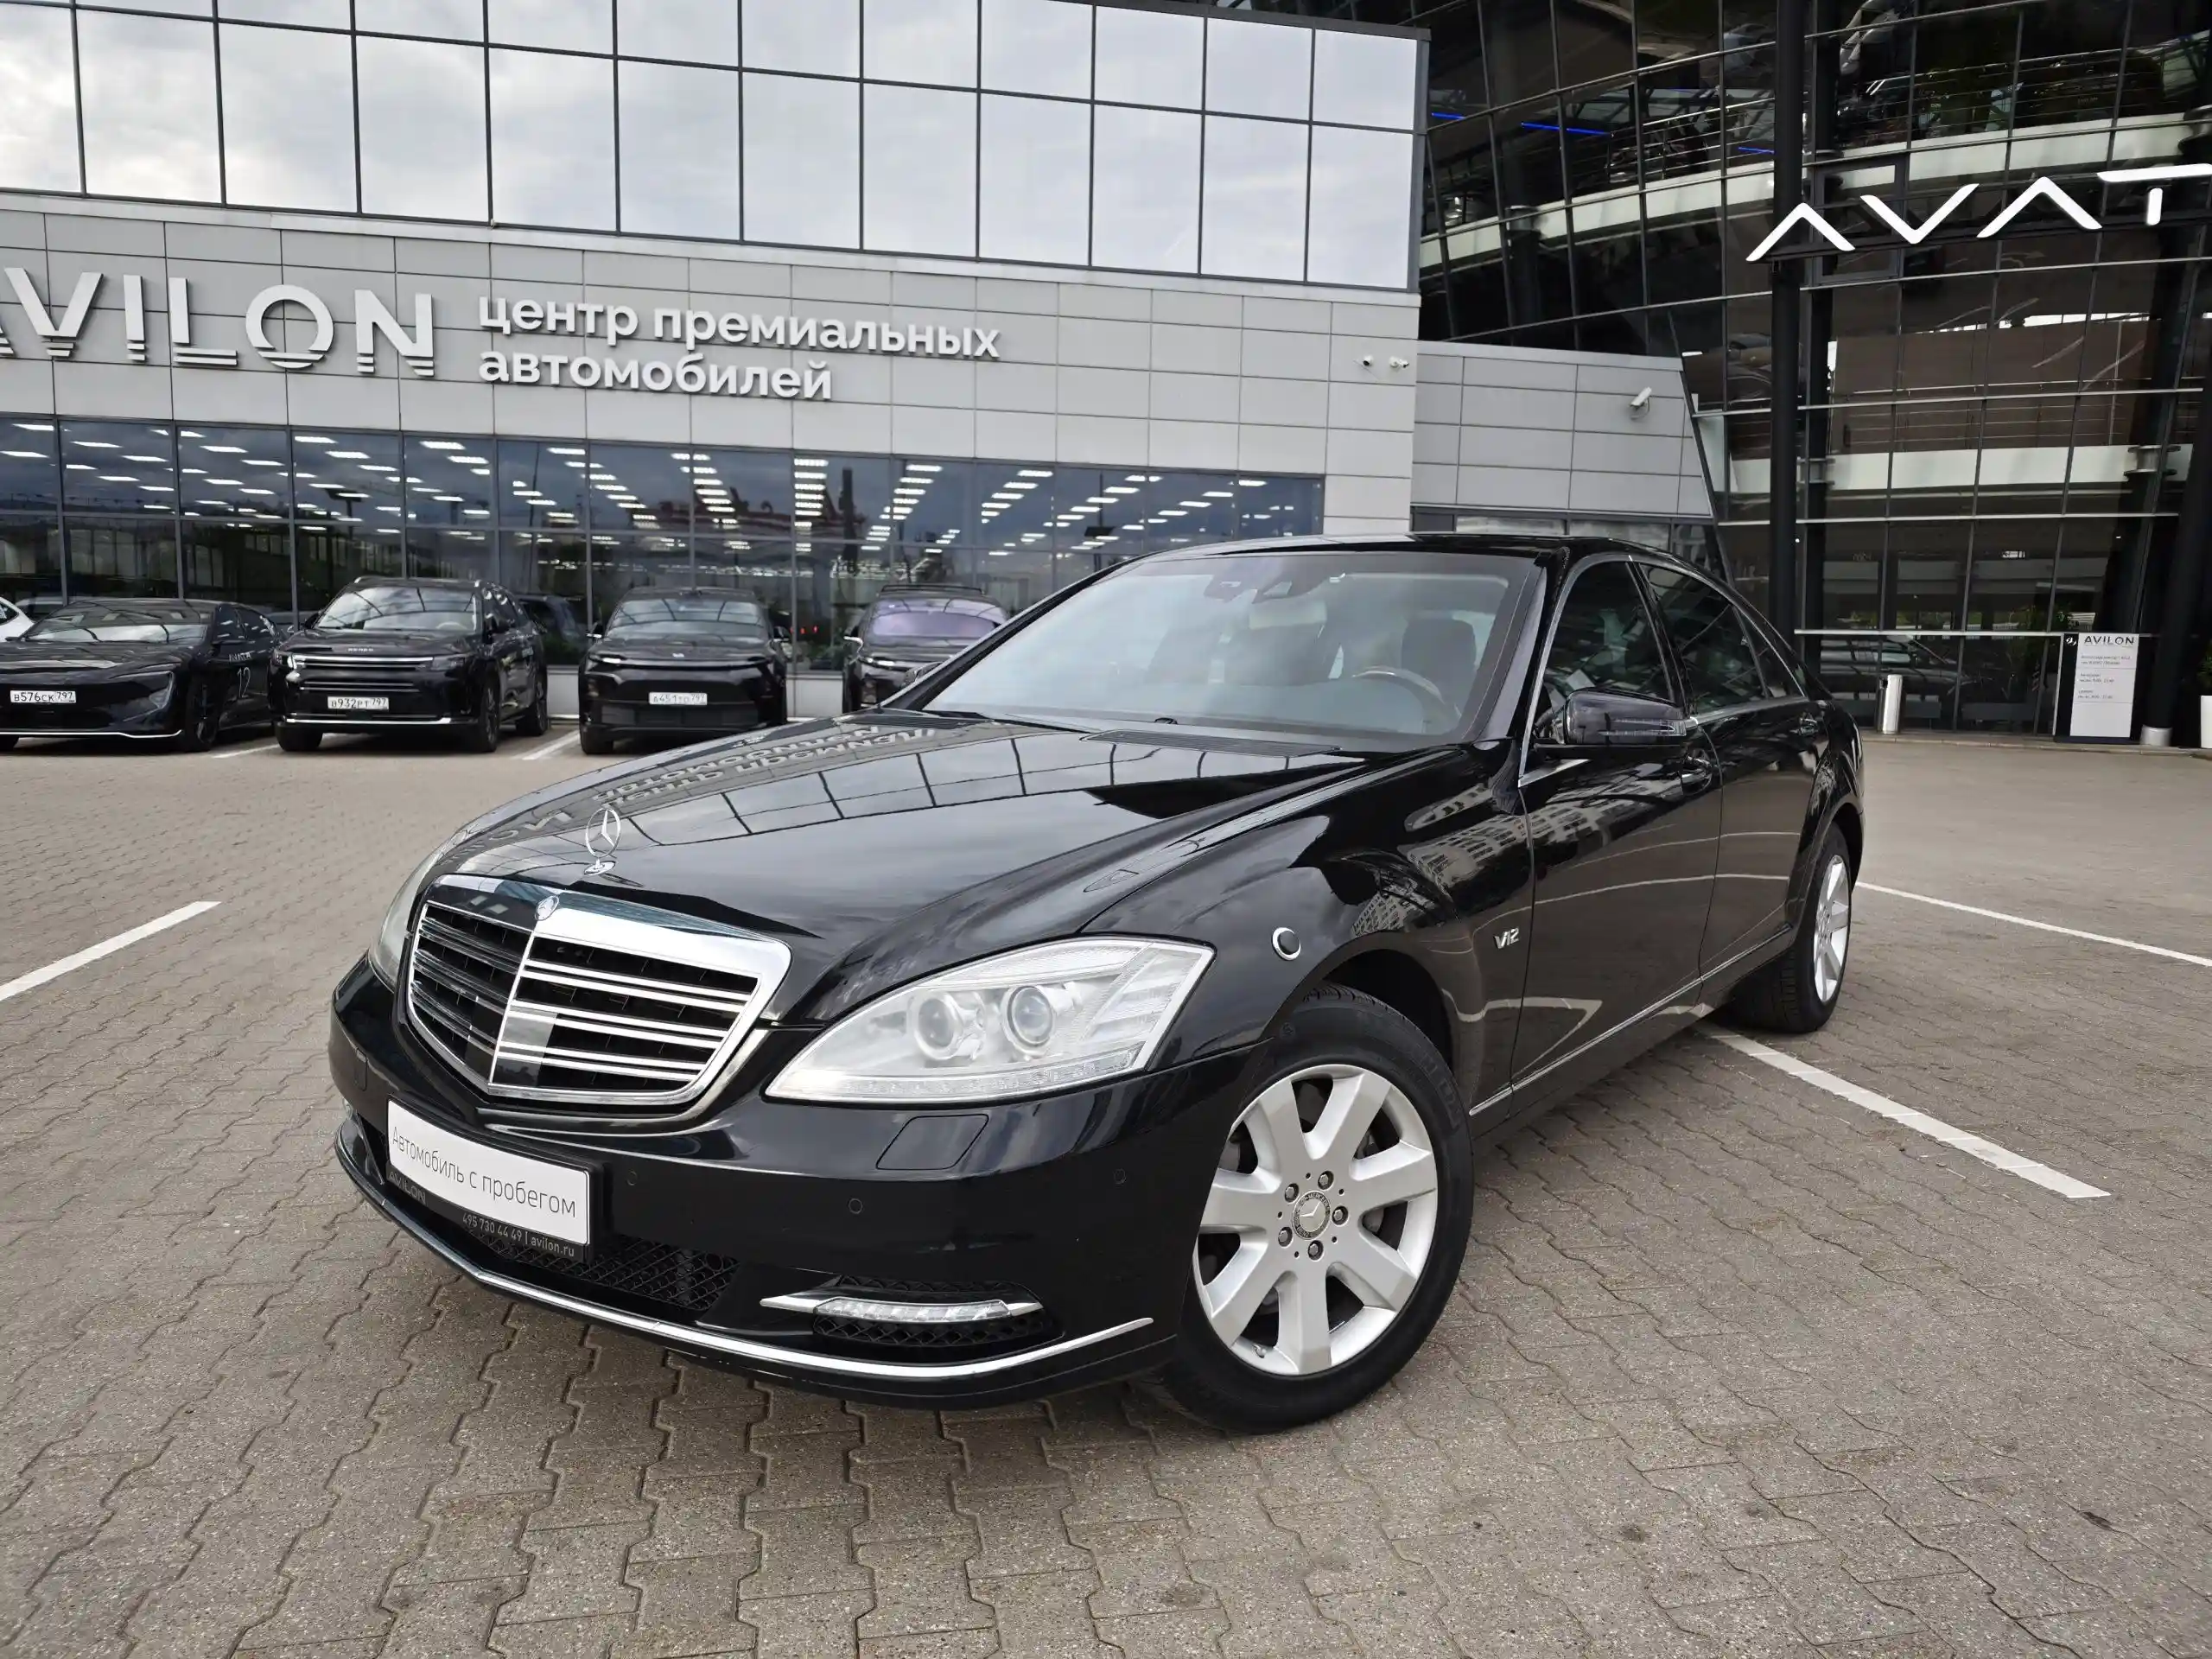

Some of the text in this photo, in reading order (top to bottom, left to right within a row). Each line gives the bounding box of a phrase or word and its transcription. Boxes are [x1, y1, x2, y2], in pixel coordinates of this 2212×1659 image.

[0, 267, 435, 377] VILON
[479, 292, 1000, 359] центр премиальных
[479, 349, 833, 401] автомобилей
[2084, 635, 2134, 647] AVILON
[237, 666, 251, 698] 12
[1494, 927, 1520, 949] V12
[389, 1171, 427, 1206] AVILON
[392, 1126, 465, 1184] Автомобиль
[482, 1175, 576, 1218] пробегом
[462, 1211, 478, 1228] 495
[480, 1217, 495, 1234] 730
[497, 1225, 509, 1238] 44
[511, 1229, 523, 1242] 49
[531, 1236, 575, 1257] avilon.ru
